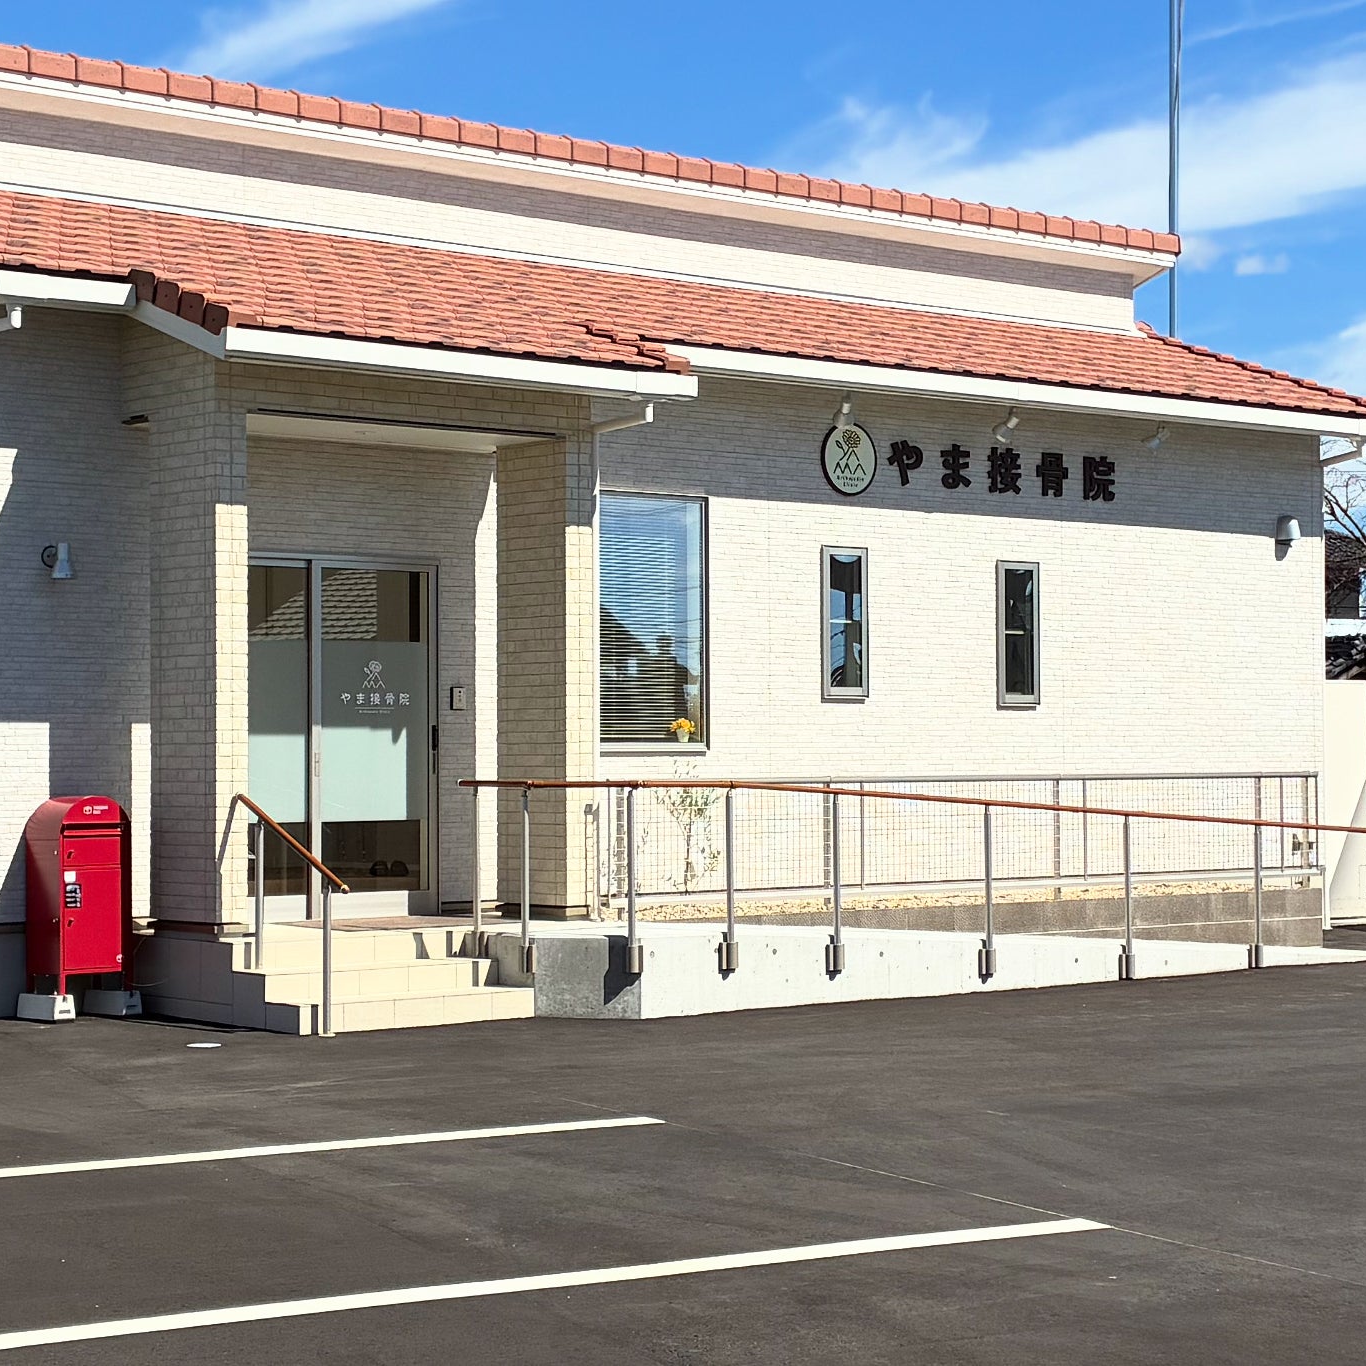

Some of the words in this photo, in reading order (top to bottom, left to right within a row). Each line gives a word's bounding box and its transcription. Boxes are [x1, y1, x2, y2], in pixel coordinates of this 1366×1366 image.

[886, 439, 1116, 502] やま接骨院
[340, 692, 410, 706] やま接骨院
